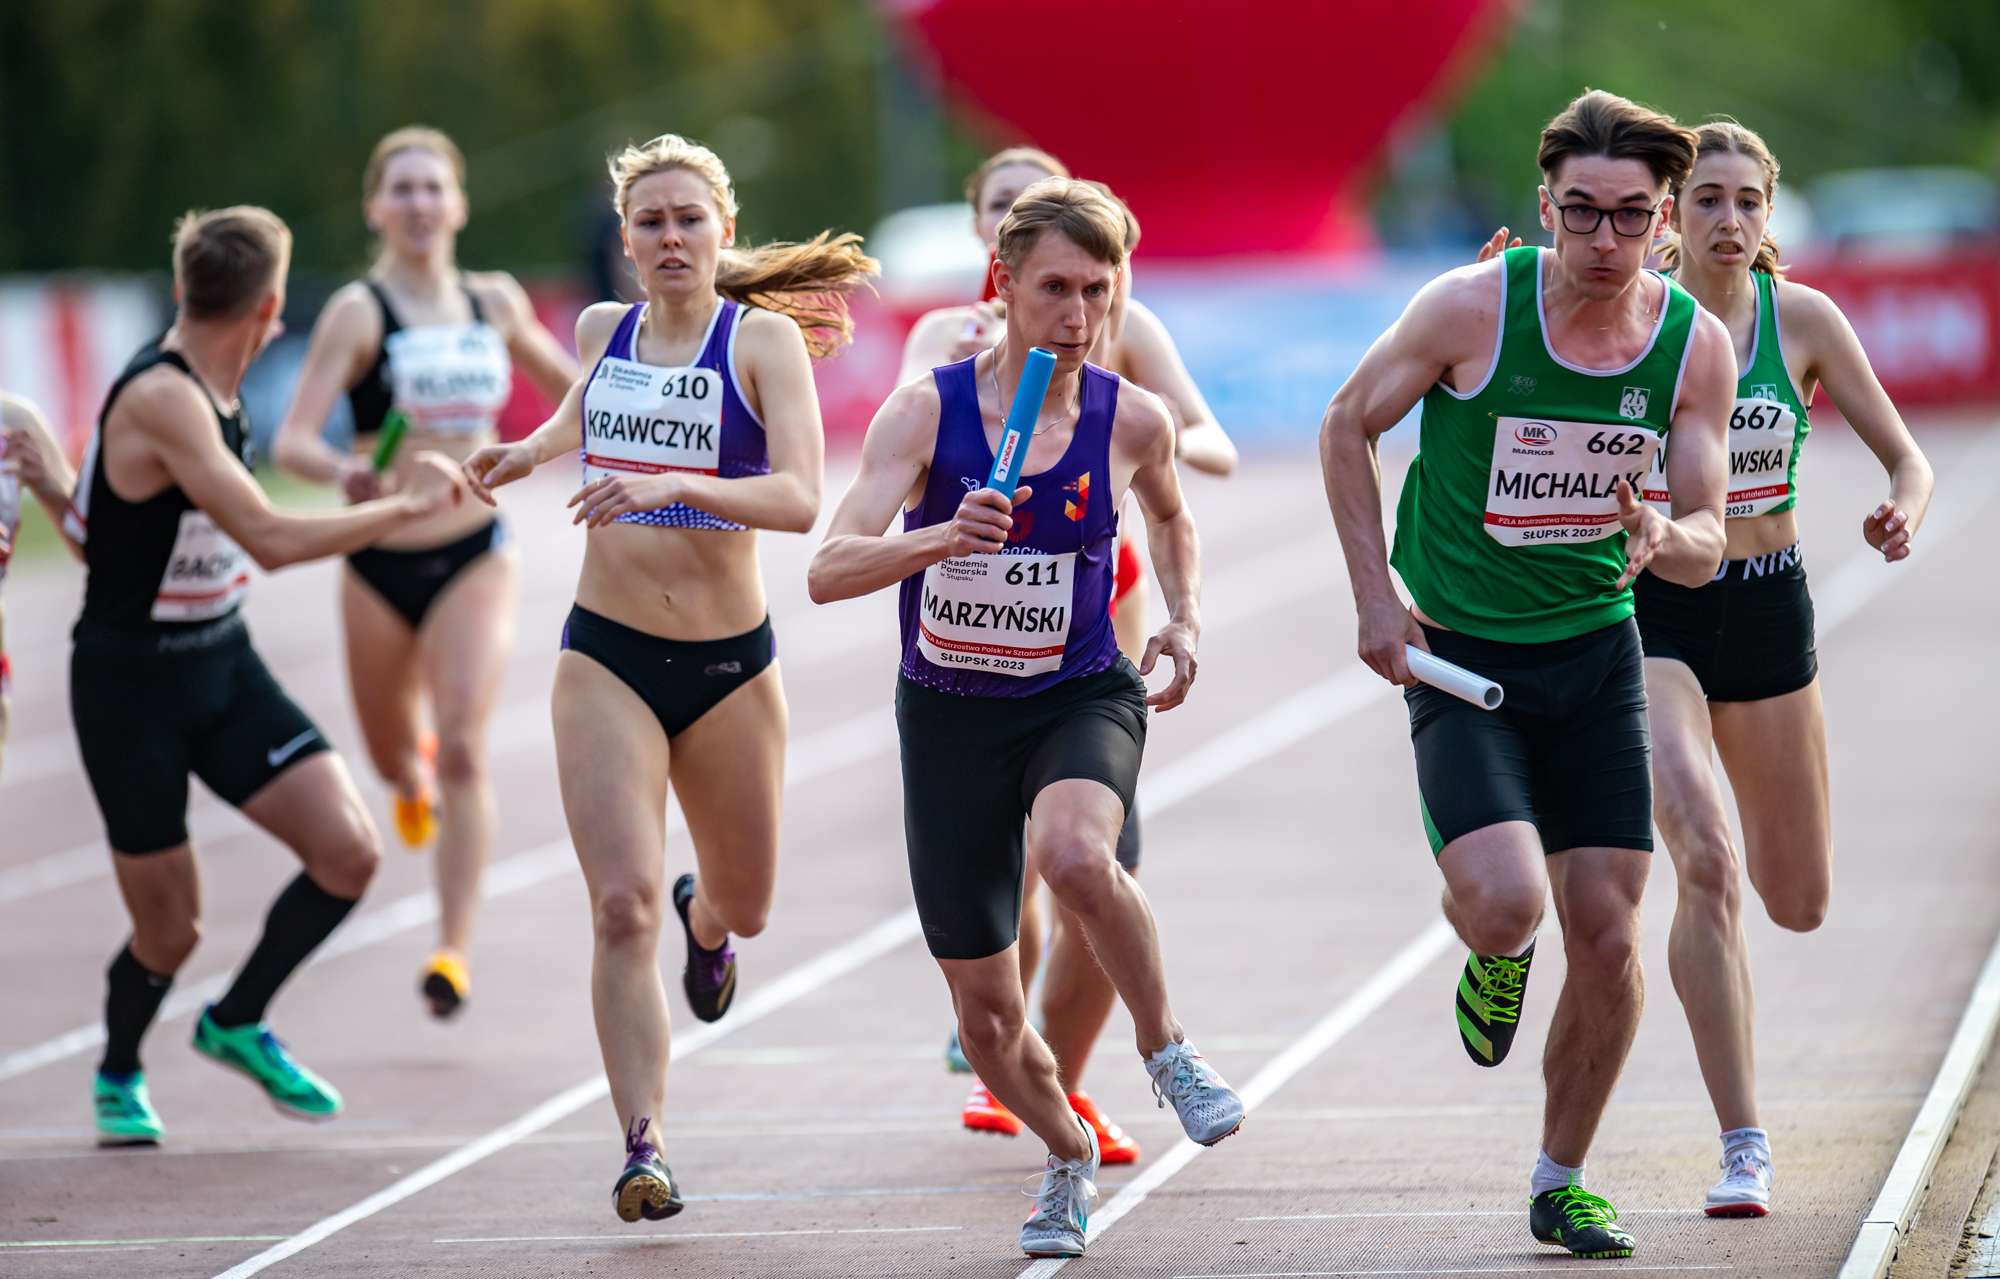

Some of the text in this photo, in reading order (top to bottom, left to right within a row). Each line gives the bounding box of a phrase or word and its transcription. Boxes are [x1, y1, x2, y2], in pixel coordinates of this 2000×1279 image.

[661, 374, 709, 400] 610
[1730, 405, 1783, 430] 667
[588, 408, 714, 452] KRAWCZYK
[1522, 426, 1548, 439] MK
[1002, 433, 1017, 467] polanik
[1512, 447, 1555, 456] MARKOS
[1587, 431, 1646, 455] 662
[1729, 448, 1784, 475] WSKA
[1495, 469, 1645, 500] MICHALAK
[1649, 492, 1667, 501] PZLA
[1725, 504, 1754, 516] 2023
[1498, 517, 1516, 525] PZLA
[1518, 517, 1560, 526] Mistrzostwa
[1561, 516, 1584, 524] Polski
[1522, 527, 1602, 540] SŁUPSK 2023
[940, 564, 988, 576] Pomorska
[942, 558, 989, 569] Akademia
[946, 573, 974, 582] Słupsku
[1004, 561, 1060, 586] 611
[923, 584, 1065, 633] MARZYŃSKI
[935, 639, 981, 652] Mistrzostwa
[981, 645, 1004, 655] Polski
[1012, 648, 1053, 657] Sztafetach
[940, 652, 1026, 670] SŁUPSK 2023
